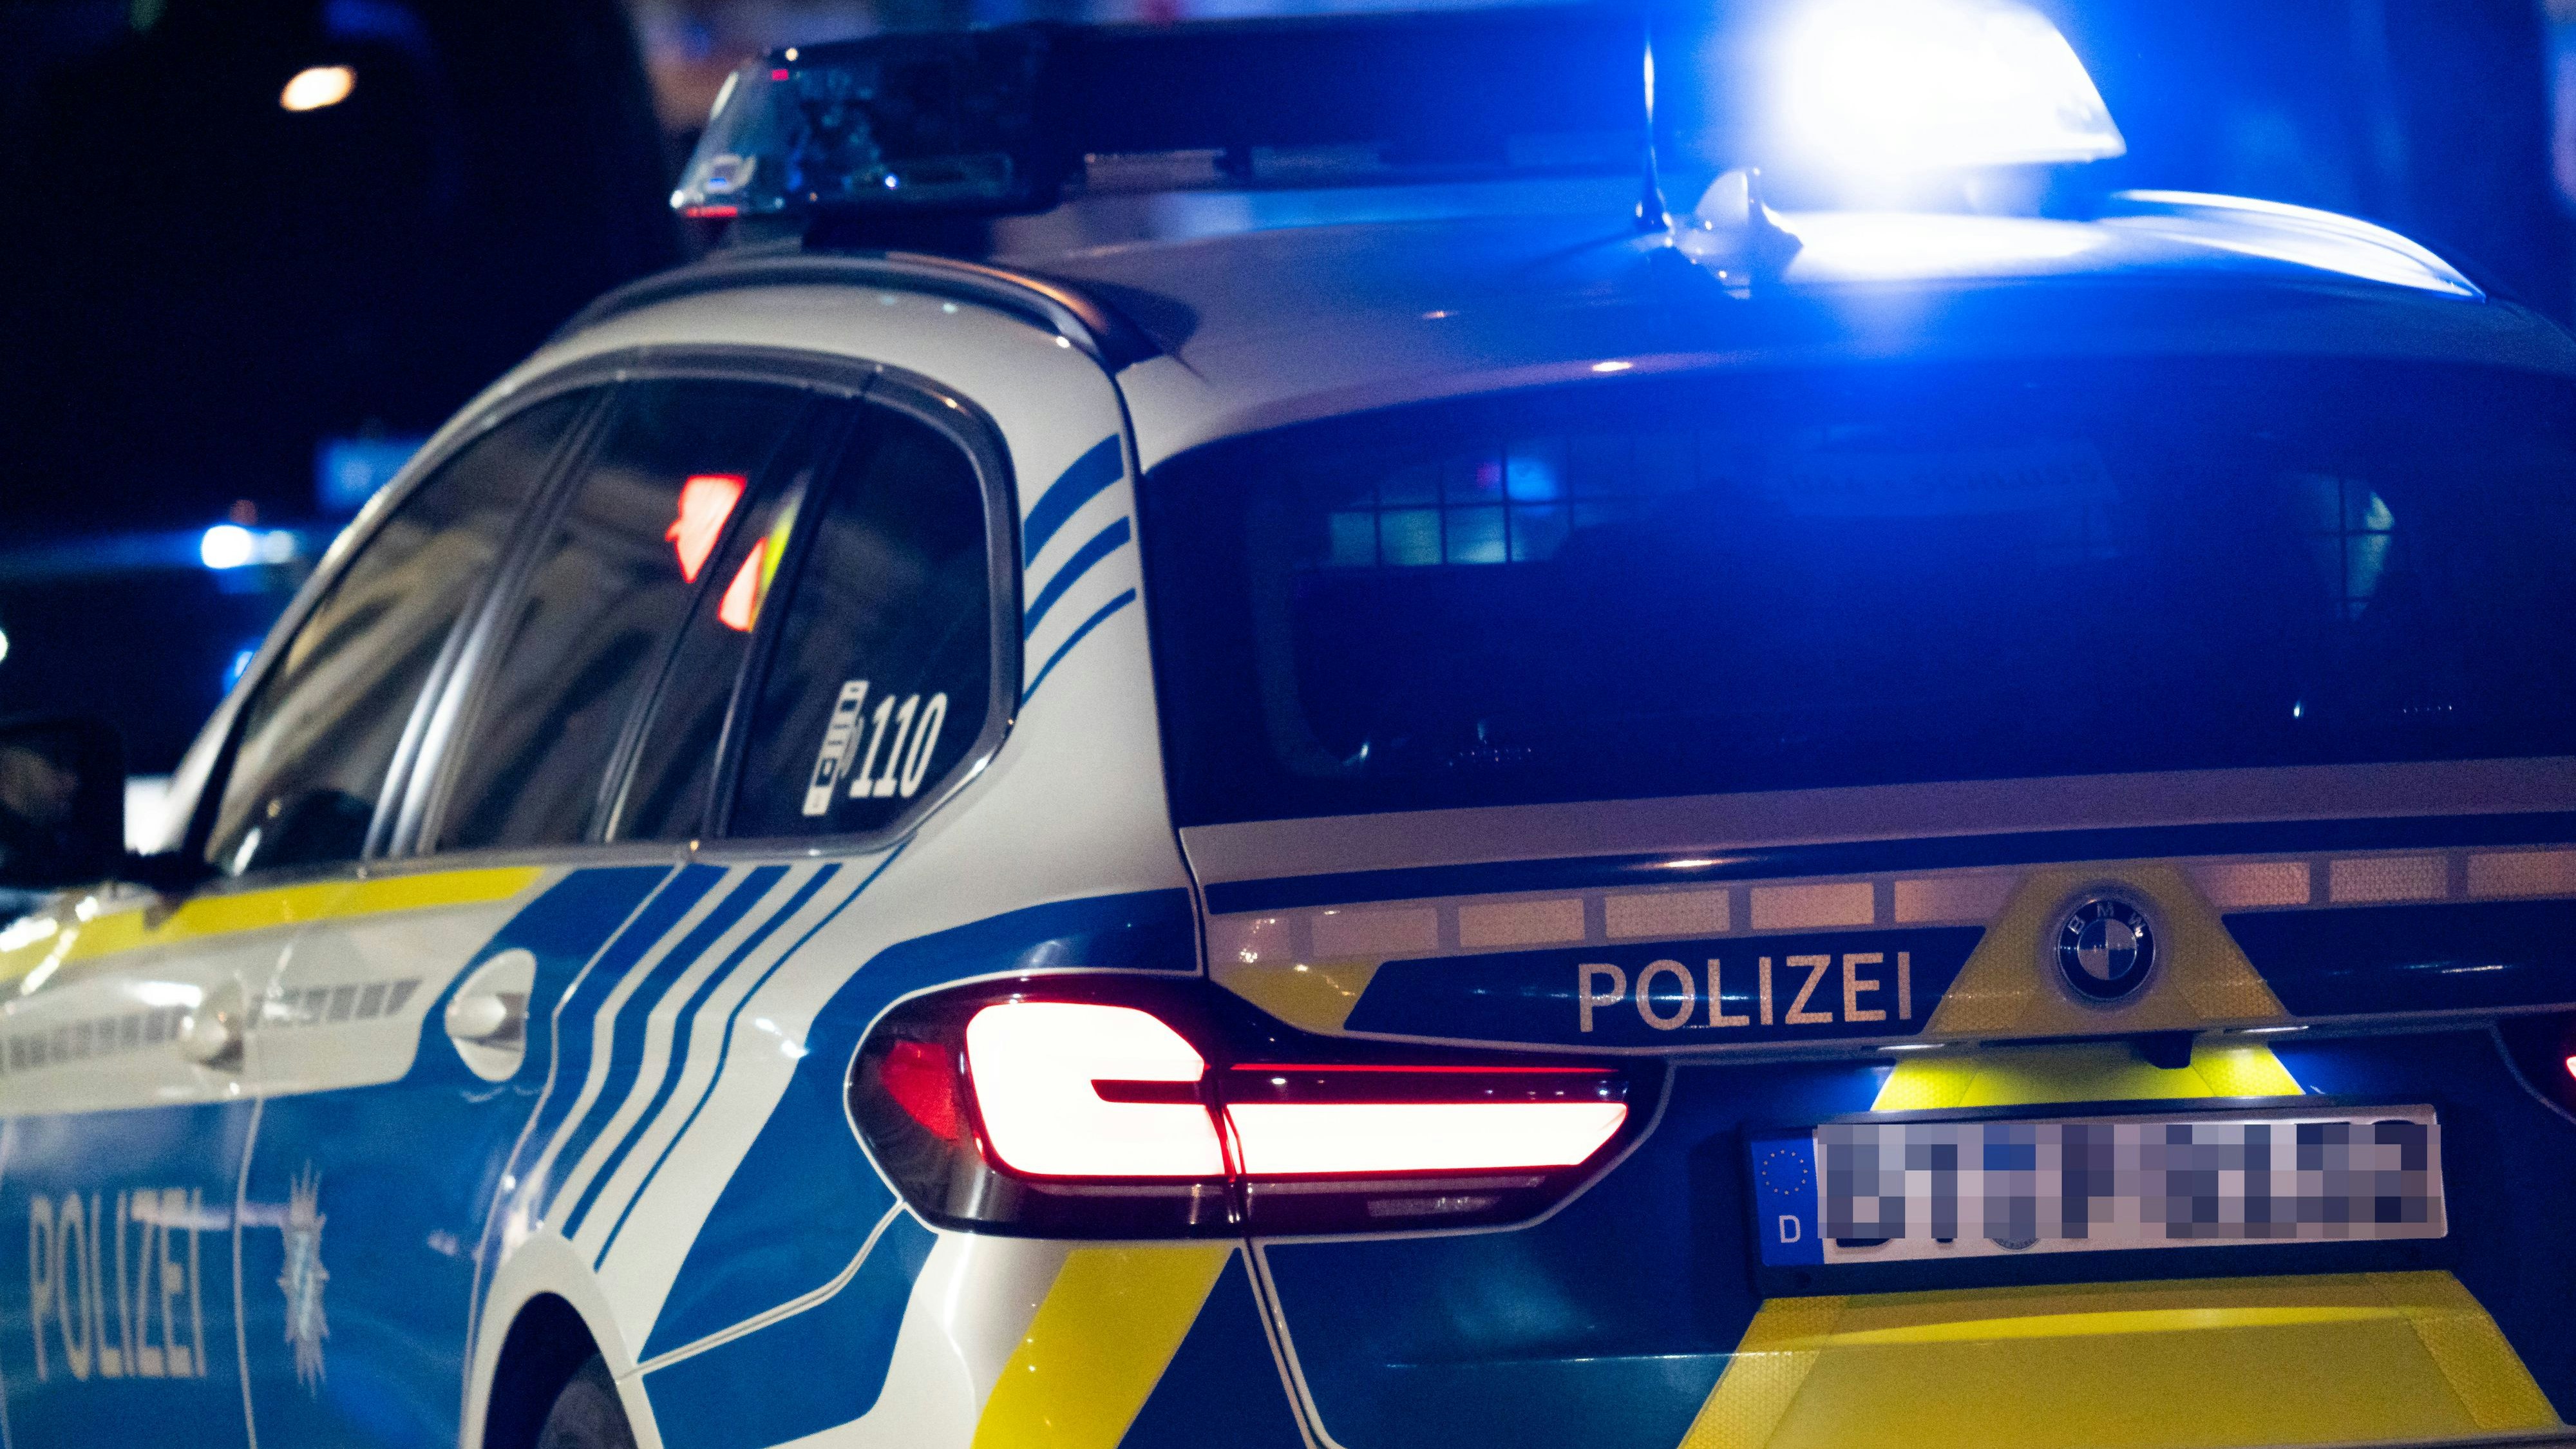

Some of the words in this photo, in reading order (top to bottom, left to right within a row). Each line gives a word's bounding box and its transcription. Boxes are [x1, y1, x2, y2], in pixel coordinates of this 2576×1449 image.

[849, 692, 948, 799] 110
[2067, 902, 2146, 938] BMW
[1578, 951, 1912, 1033] POLIZEI
[1779, 1215, 1801, 1243] D
[29, 1188, 206, 1382] POLIZEI
